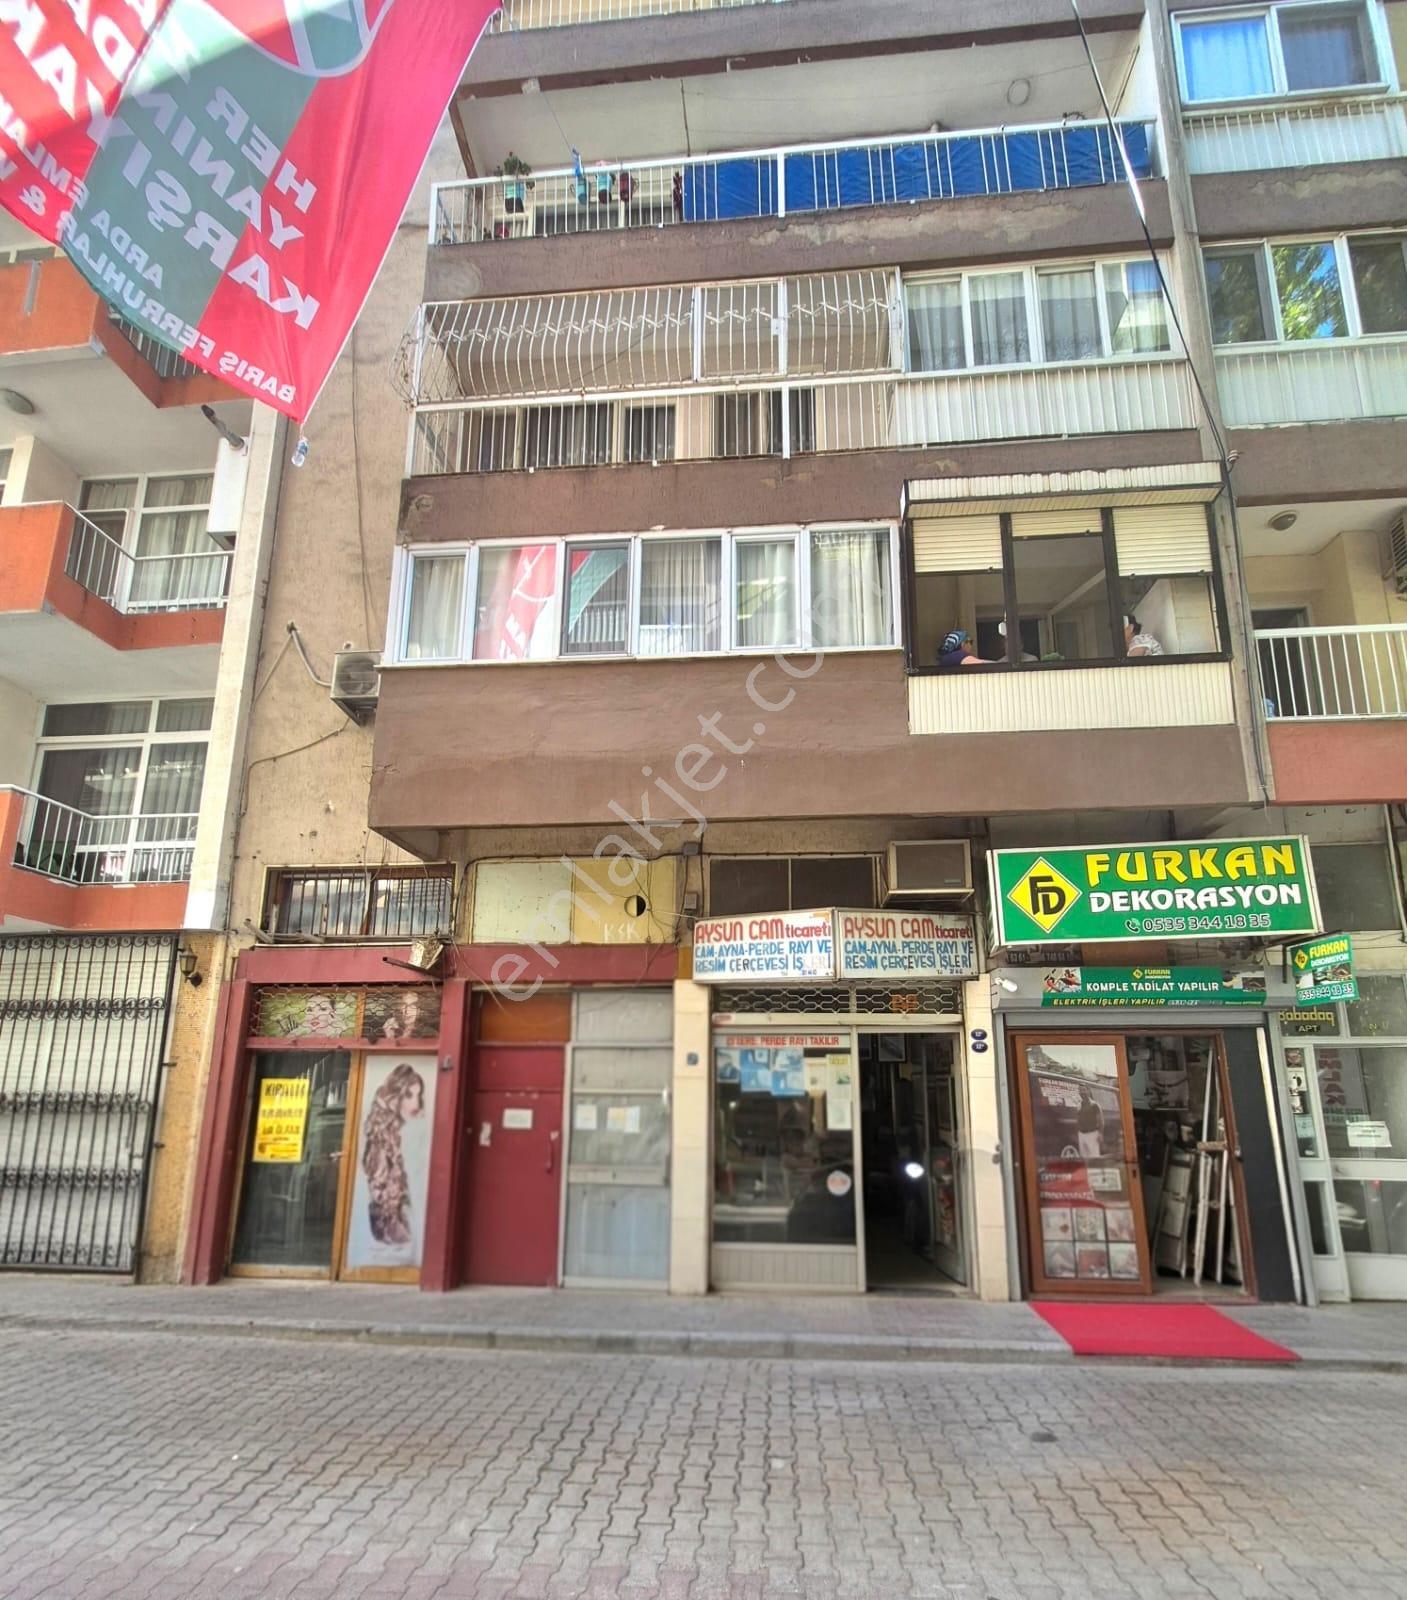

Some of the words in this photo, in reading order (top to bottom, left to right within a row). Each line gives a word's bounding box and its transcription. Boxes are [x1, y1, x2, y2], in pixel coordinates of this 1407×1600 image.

[1085, 843, 1296, 888] FURKAN
[1089, 883, 1302, 914] DEKORASYON
[695, 921, 744, 944] AYSUN
[748, 918, 785, 941] CAM
[844, 917, 896, 939] AYSUN
[901, 917, 935, 939] CAM
[1143, 917, 1186, 932] 0535
[1188, 915, 1223, 931] 344
[1224, 915, 1247, 929] 18
[1249, 913, 1272, 929] 35
[789, 940, 813, 955] RAYI
[817, 939, 832, 953] VE
[936, 941, 958, 956] RAYI
[960, 941, 973, 954] VE
[1309, 939, 1348, 959] FURKAN
[1086, 982, 1128, 992] KOMPLE
[1131, 980, 1174, 991] TADİLAT
[1178, 982, 1219, 991] YAPILIR
[1053, 997, 1098, 1006] ELEKTRİK
[1131, 998, 1165, 1006] YAPILIR
